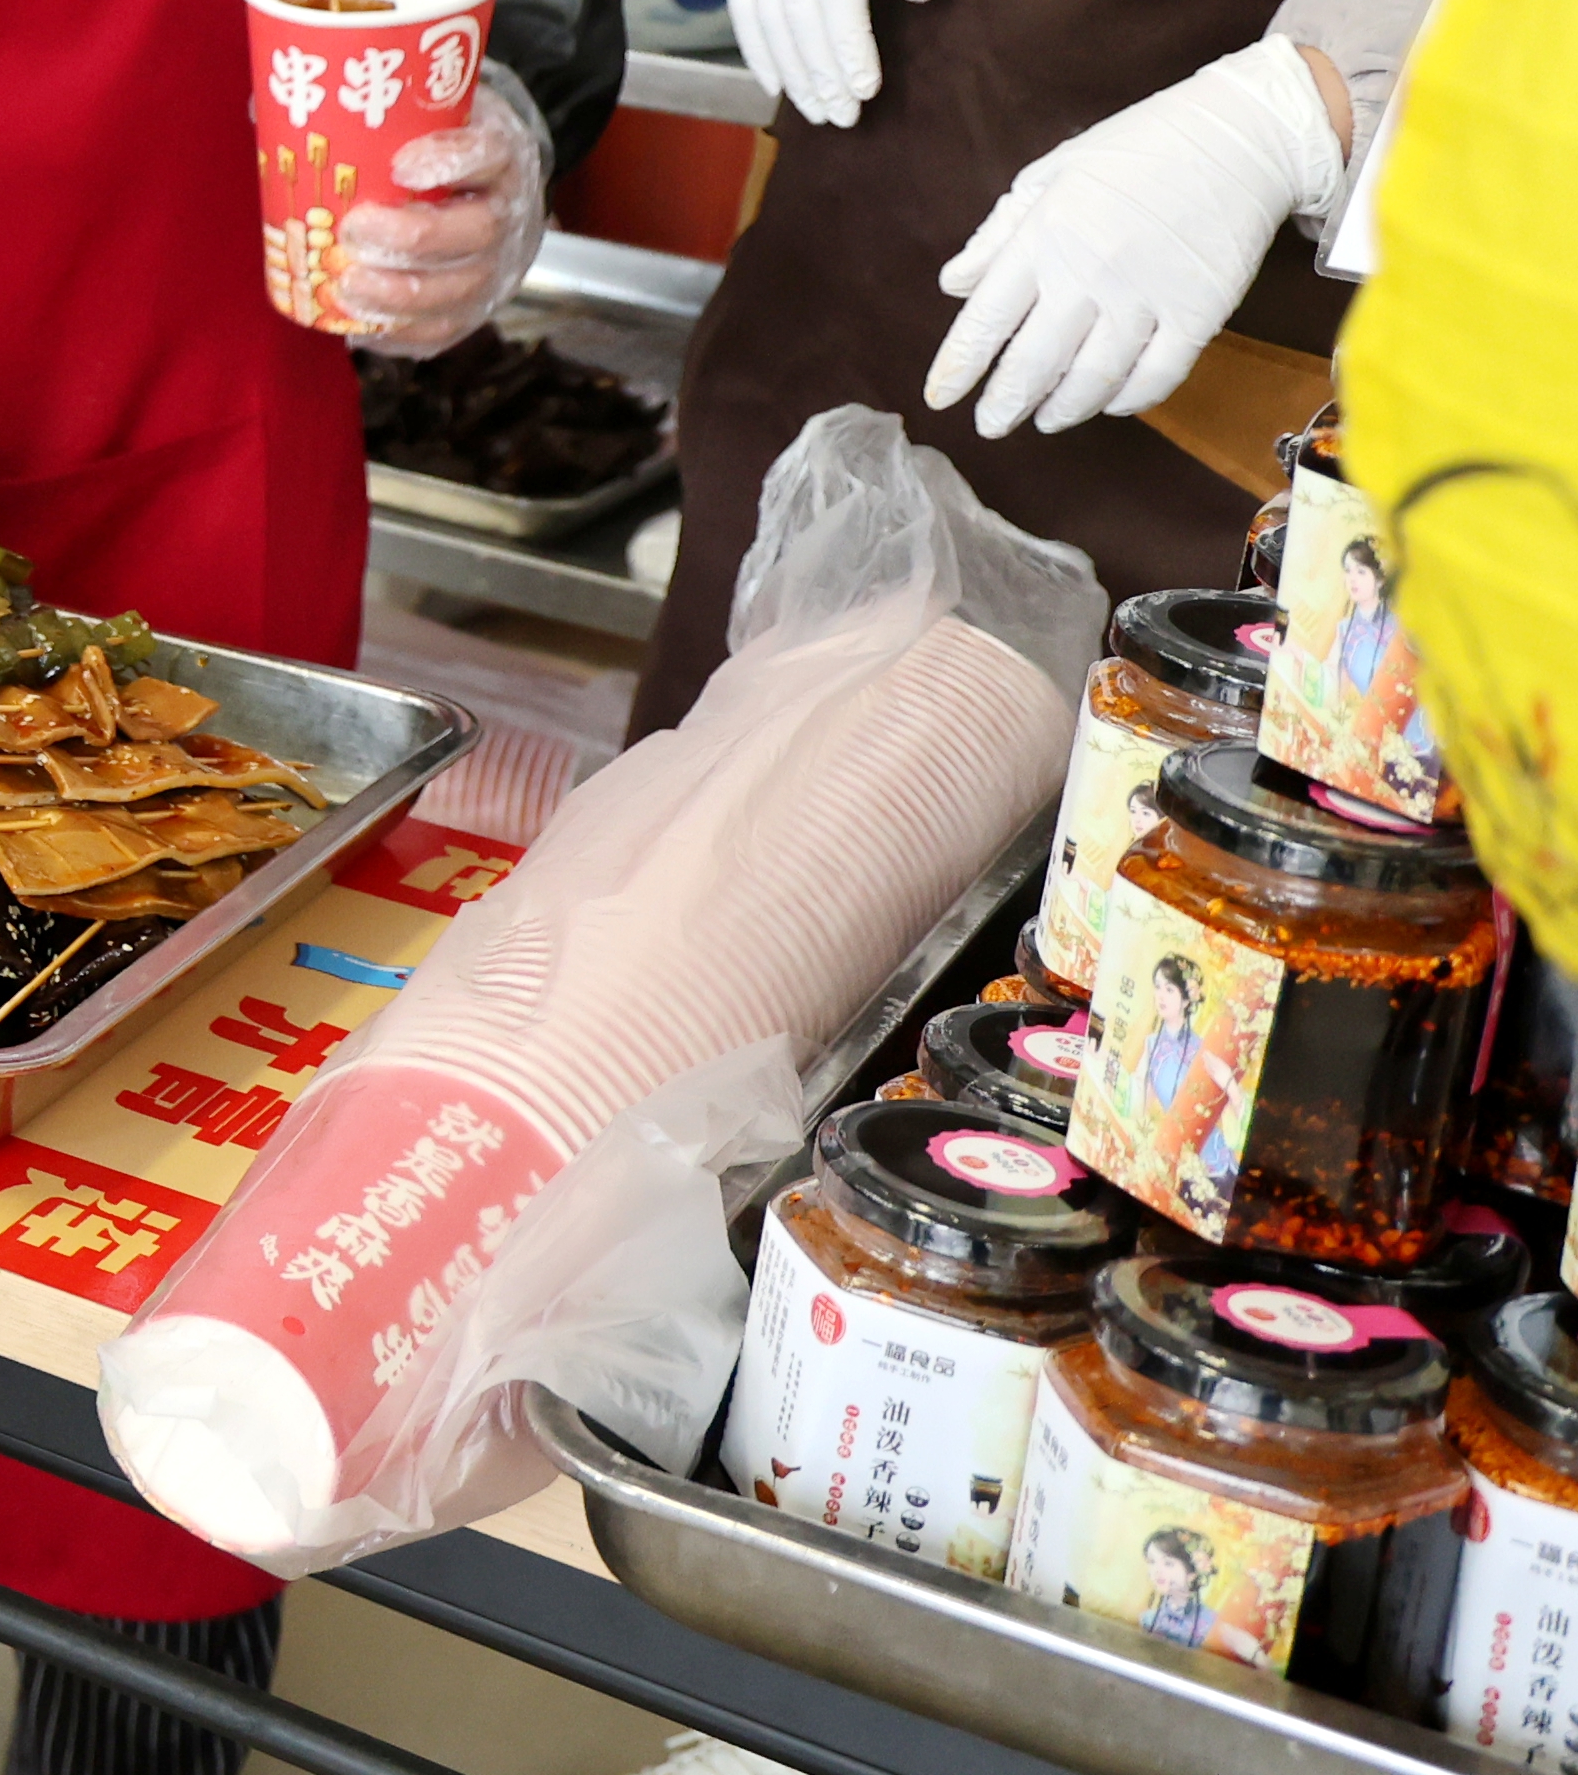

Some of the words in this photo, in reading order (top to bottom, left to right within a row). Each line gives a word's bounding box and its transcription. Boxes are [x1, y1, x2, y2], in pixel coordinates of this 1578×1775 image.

[268, 15, 482, 129] 串串香
[280, 1101, 506, 1312] 就是香麻爽
[861, 1338, 956, 1378] 一福食品
